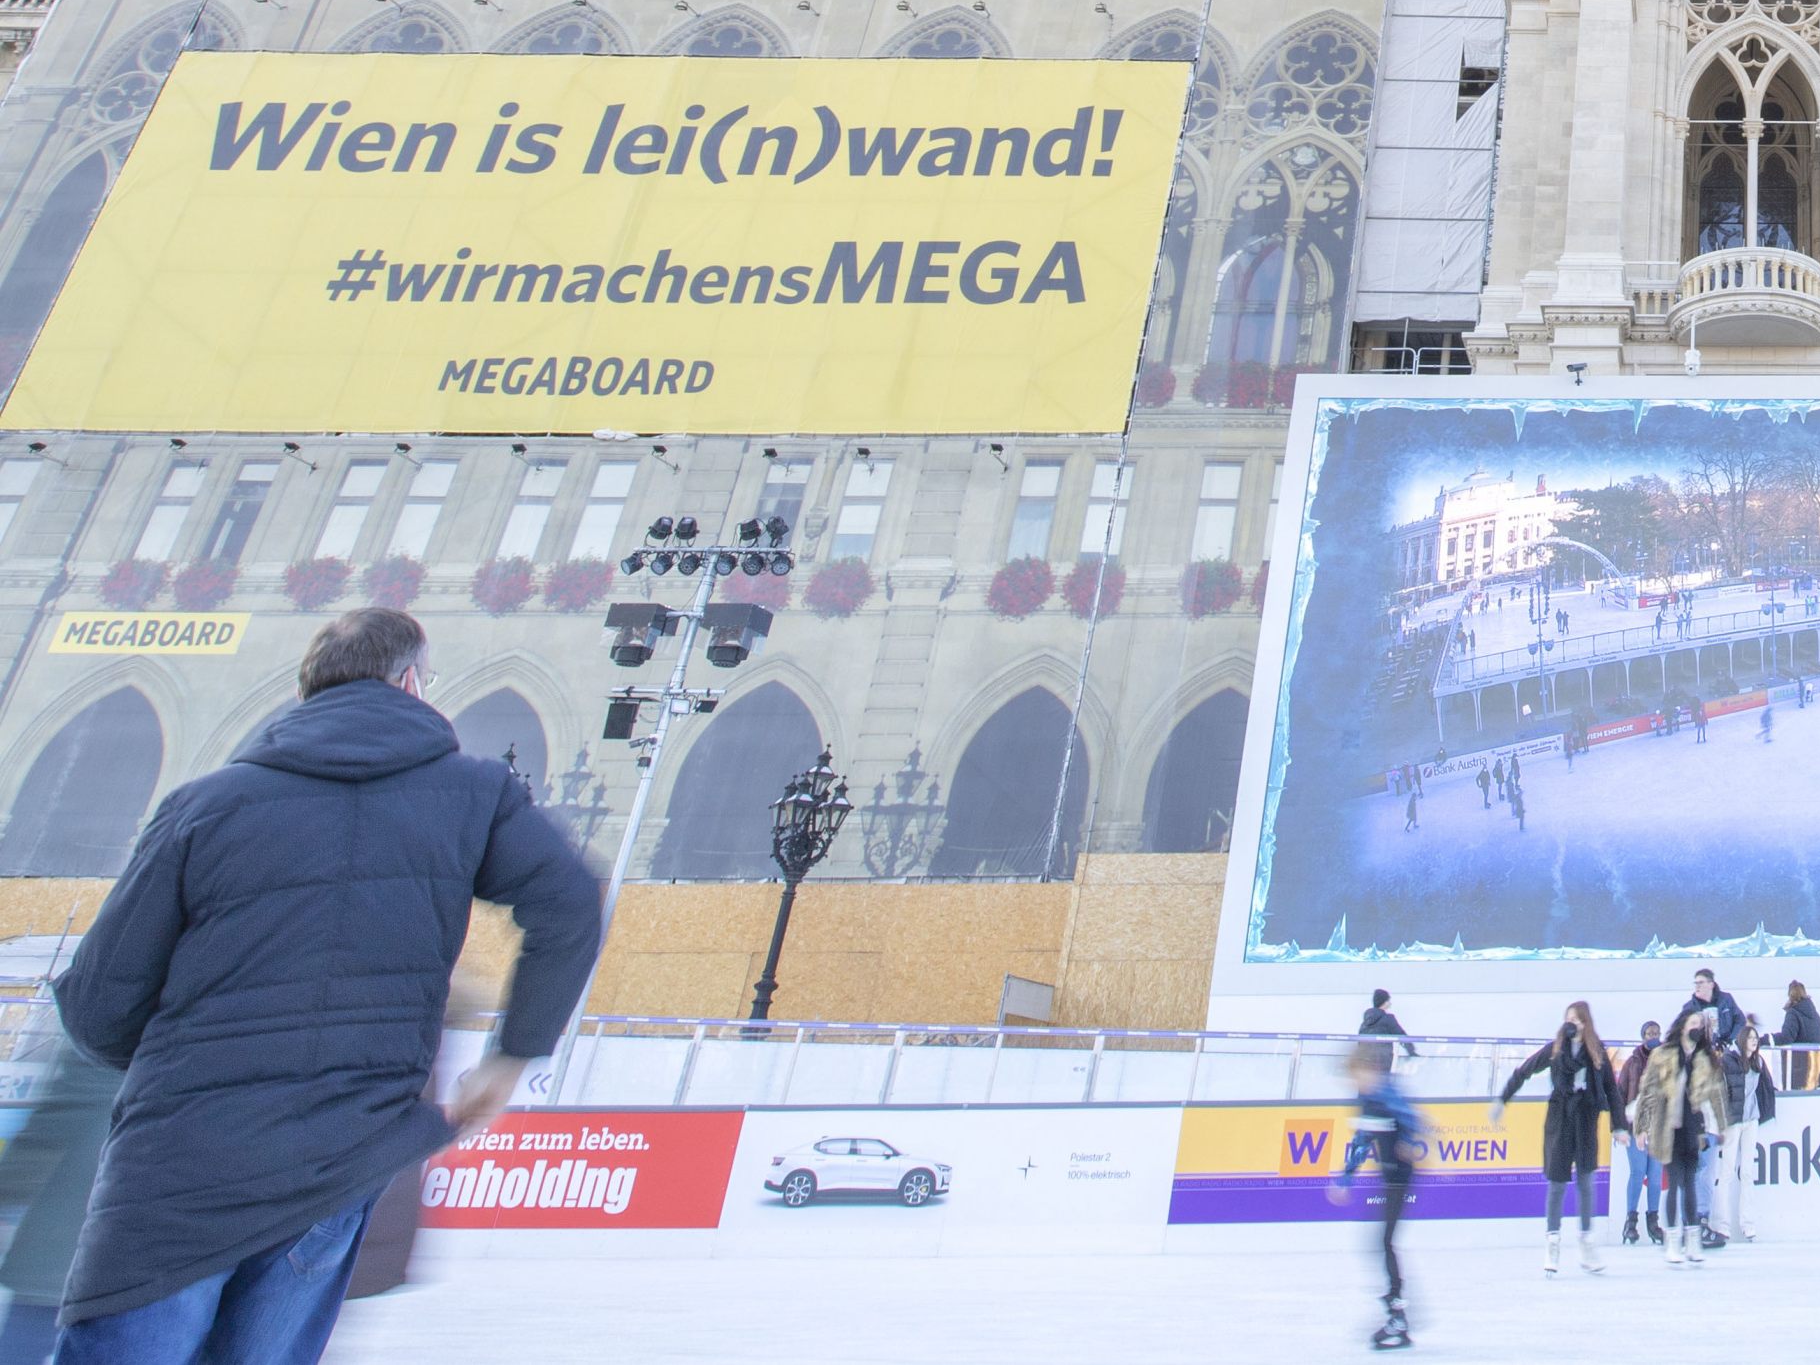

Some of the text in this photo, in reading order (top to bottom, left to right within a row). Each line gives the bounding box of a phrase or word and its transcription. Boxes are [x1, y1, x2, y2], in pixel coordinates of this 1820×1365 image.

[209, 100, 1124, 185] Wien is lei(n)wand!
[326, 240, 1087, 305] #wirmachensMEGA
[438, 356, 715, 396] MEGABOARD
[63, 620, 235, 647] MEGABOARD
[1458, 755, 1488, 771] Austria
[518, 1133, 573, 1150] zum
[577, 1127, 650, 1150] leben.
[1287, 1131, 1329, 1164] W
[1438, 1140, 1508, 1162] WIEN
[1105, 1153, 1112, 1162] 2
[1090, 1170, 1131, 1179] elektrisch
